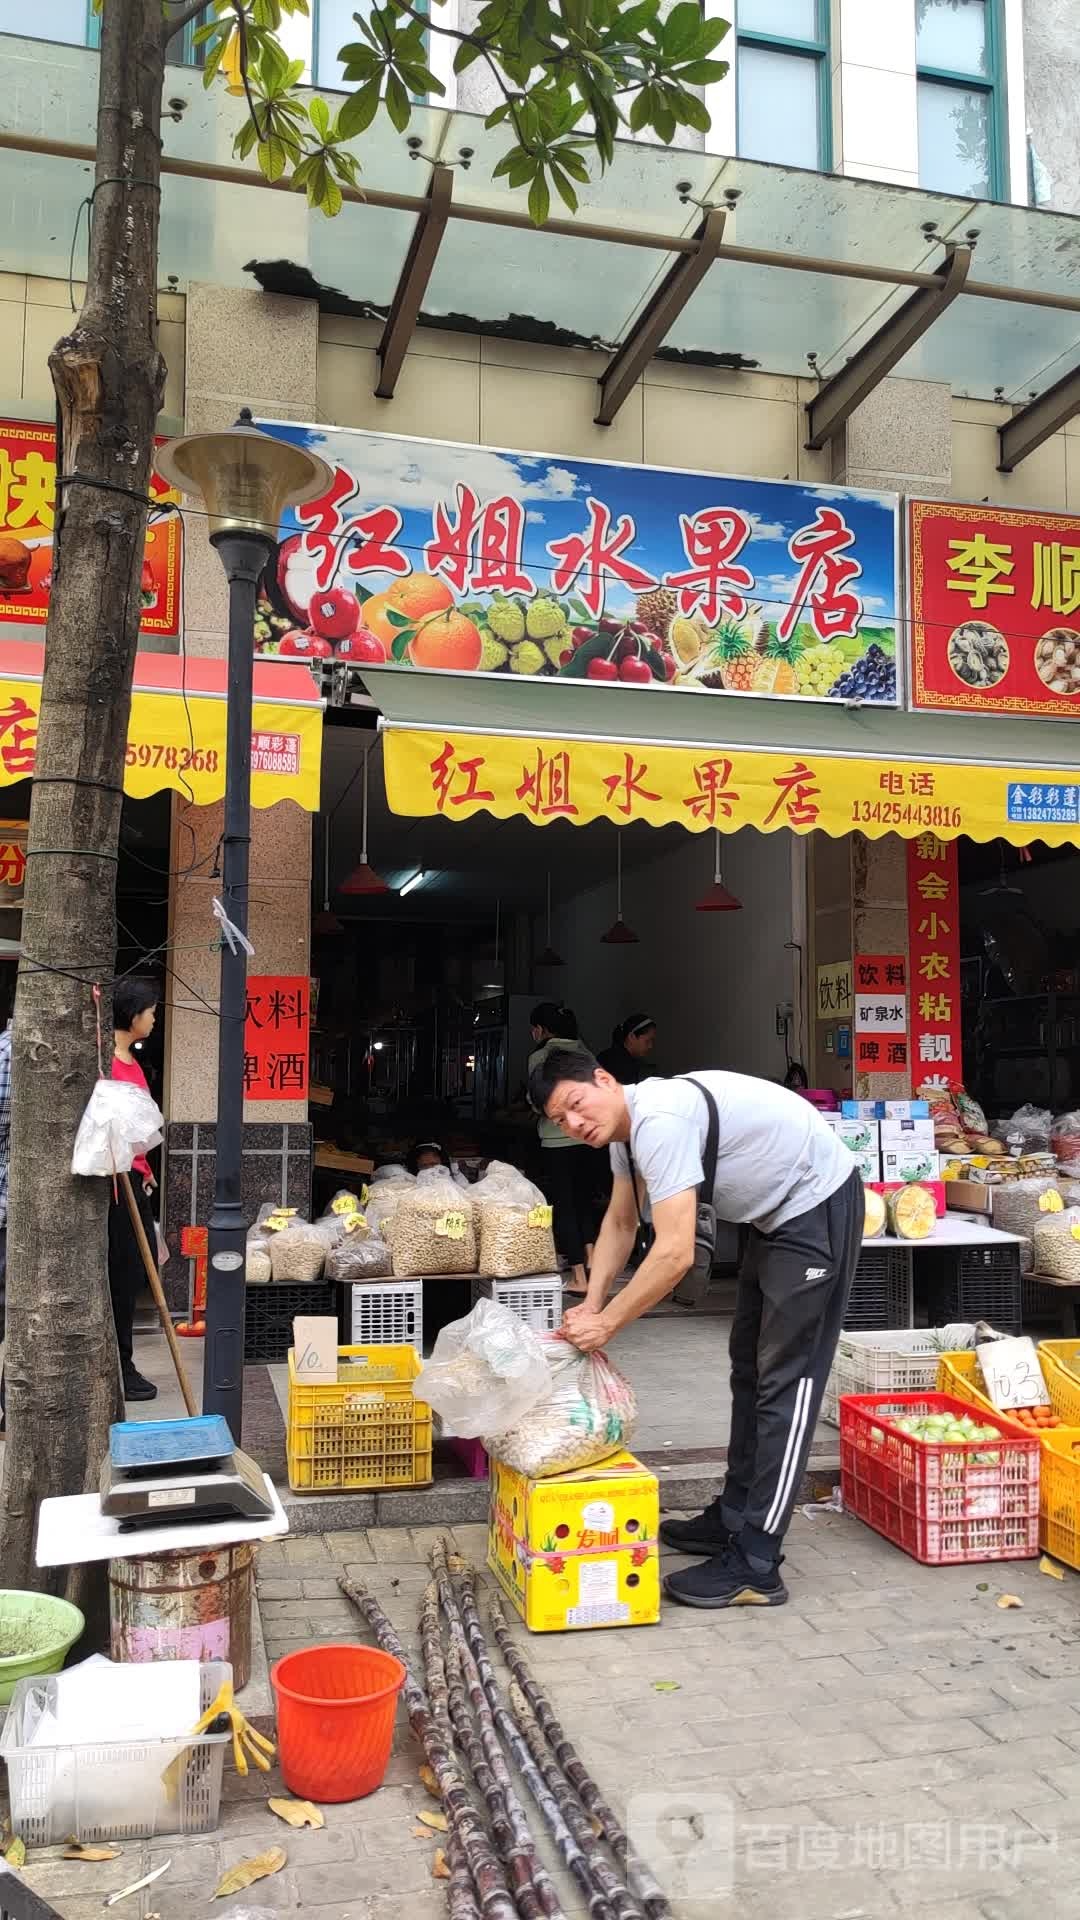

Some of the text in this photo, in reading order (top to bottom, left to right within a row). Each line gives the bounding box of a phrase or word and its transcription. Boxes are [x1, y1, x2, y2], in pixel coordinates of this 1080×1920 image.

[293, 465, 864, 642] 红姐水果店
[430, 740, 822, 826] 红姐水果店
[879, 770, 936, 797] 电话
[851, 800, 962, 828] 13425443816
[858, 963, 905, 986] 饮料
[819, 972, 851, 1011] 饮料
[859, 1004, 903, 1022] 矿泉水
[859, 1041, 907, 1065] 啤酒
